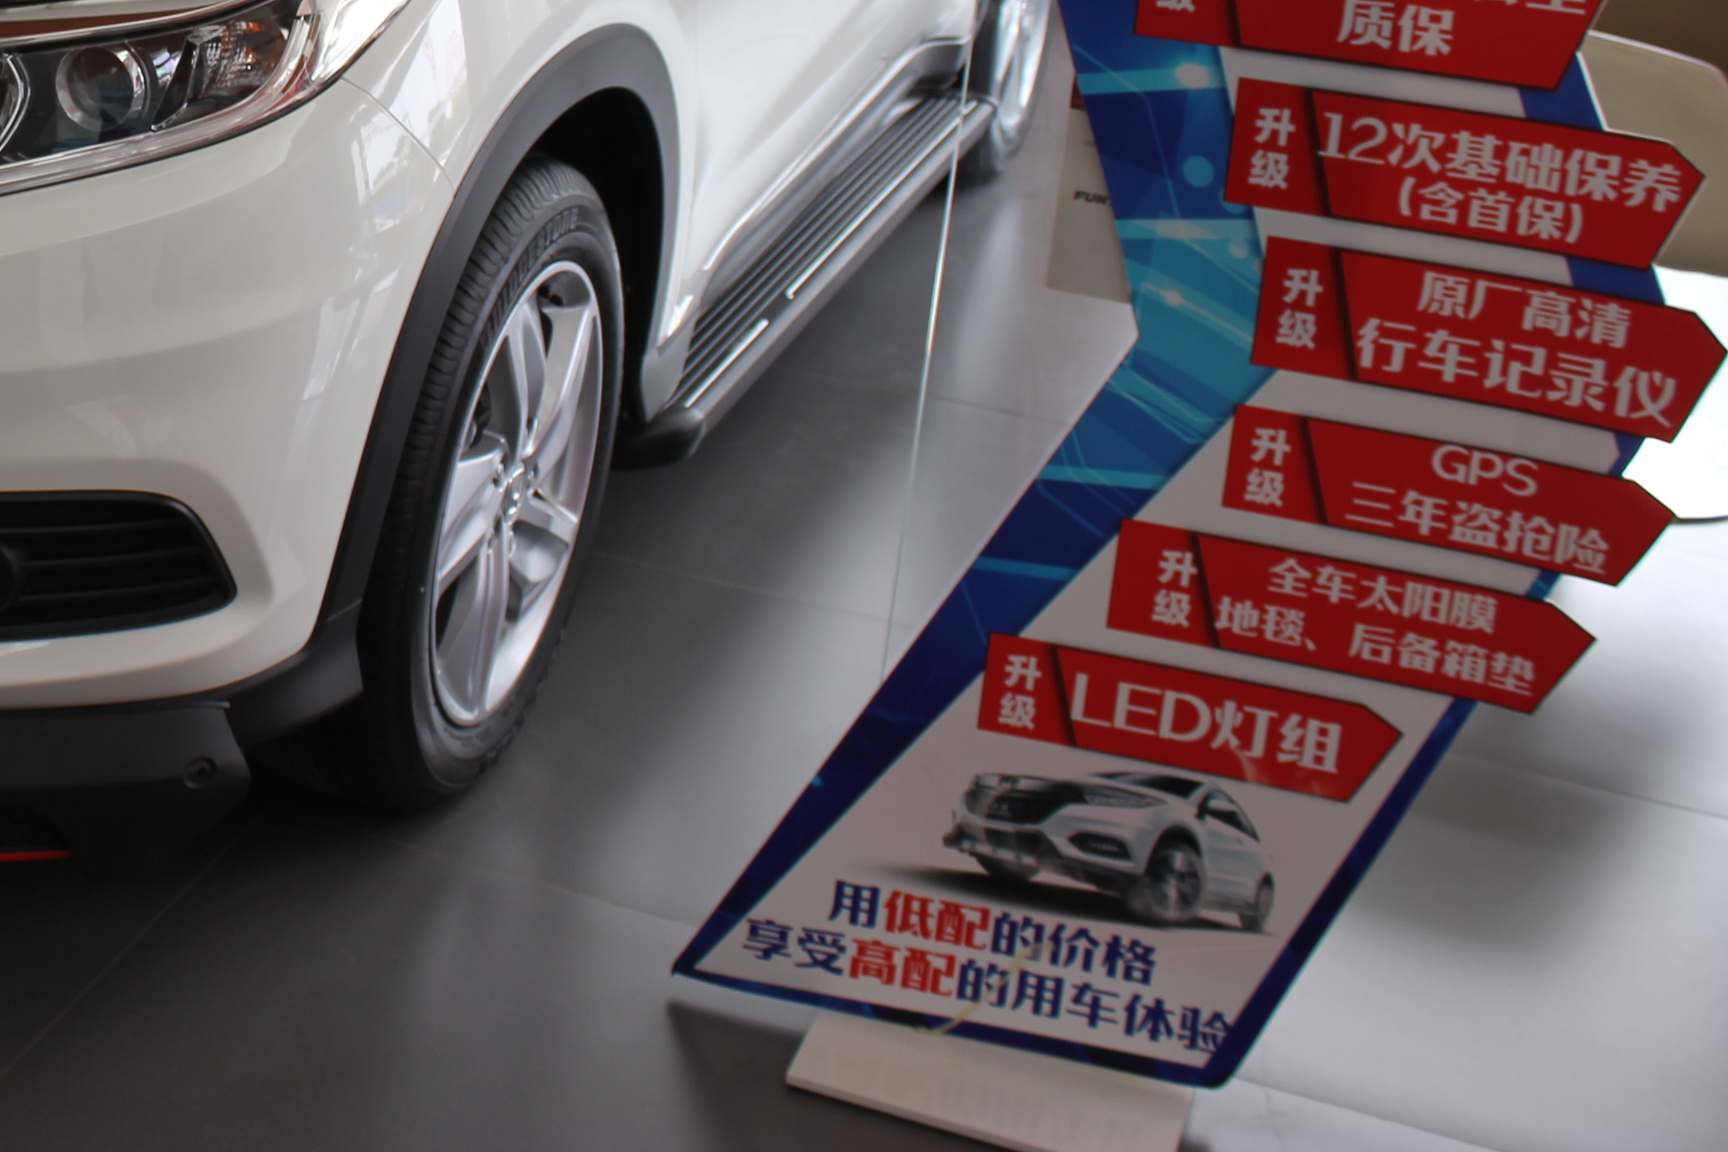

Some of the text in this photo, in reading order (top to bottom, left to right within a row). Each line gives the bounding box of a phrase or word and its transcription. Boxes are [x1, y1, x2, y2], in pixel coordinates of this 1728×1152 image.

[1248, 106, 1296, 192] 升级
[1317, 111, 1681, 214] 12次基础保养
[1397, 175, 1584, 245] (含首保)
[1276, 267, 1324, 351] 升级
[1417, 270, 1632, 350] 原厂高清
[1356, 316, 1677, 430] 行车记录仪
[1244, 427, 1292, 509] 升级
[1430, 444, 1540, 498] GPS
[1344, 479, 1610, 576] 三年盗抢险
[1151, 550, 1198, 629] 升级
[1268, 557, 1499, 635] 全车太阳膜
[998, 653, 1042, 730] 升级
[1071, 673, 1343, 774] LED灯组
[828, 879, 1158, 986] 用低配的价格
[740, 917, 1234, 1055] 享受高配的用车体验
